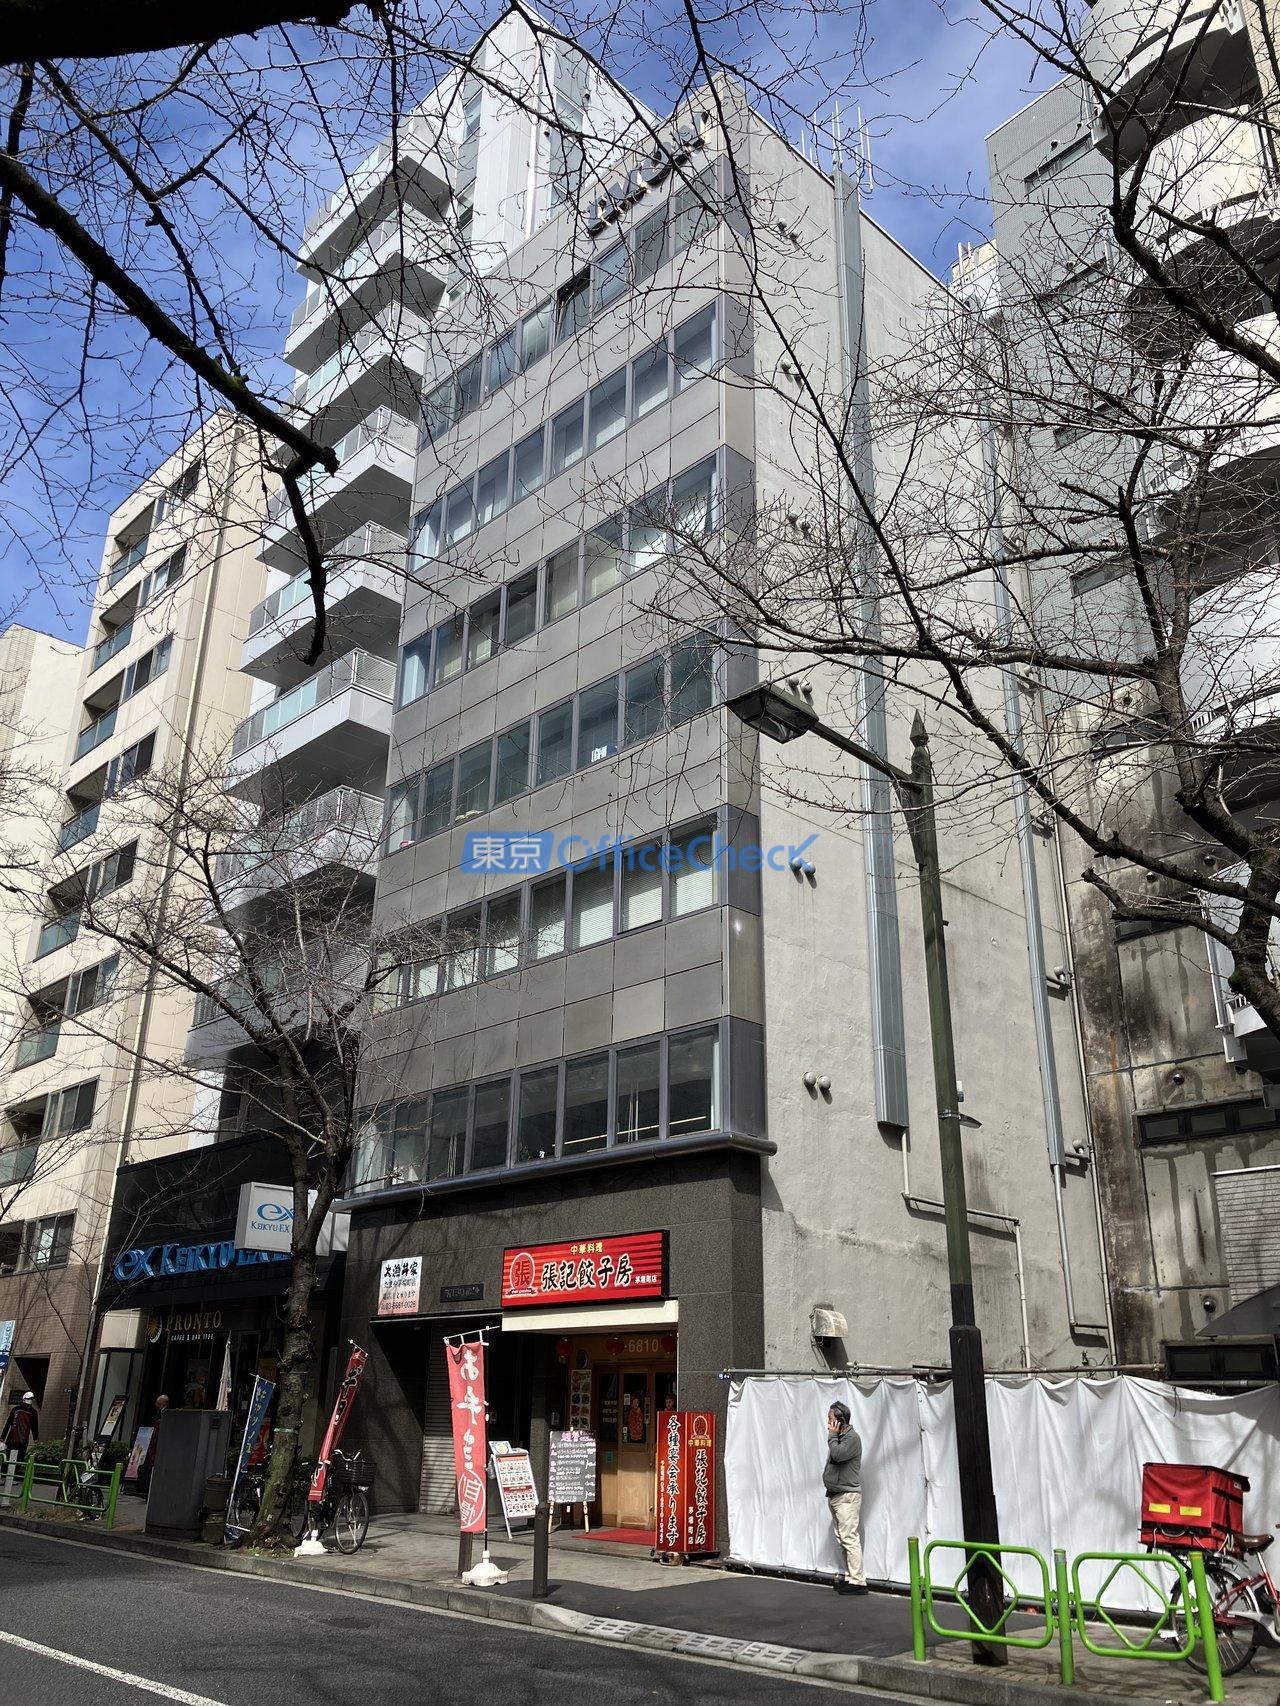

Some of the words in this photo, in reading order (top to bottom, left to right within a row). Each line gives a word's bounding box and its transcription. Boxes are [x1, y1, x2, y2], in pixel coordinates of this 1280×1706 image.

[251, 1220, 279, 1231] KEIKYU
[159, 1240, 235, 1276] KEIKYU
[570, 1242, 603, 1255] 中華料理
[541, 1252, 634, 1292] 張記餃子房
[165, 1310, 222, 1332] PRONTO
[666, 1415, 681, 1547] 各種宴会承ります
[694, 1448, 708, 1545] 張記餃子房
